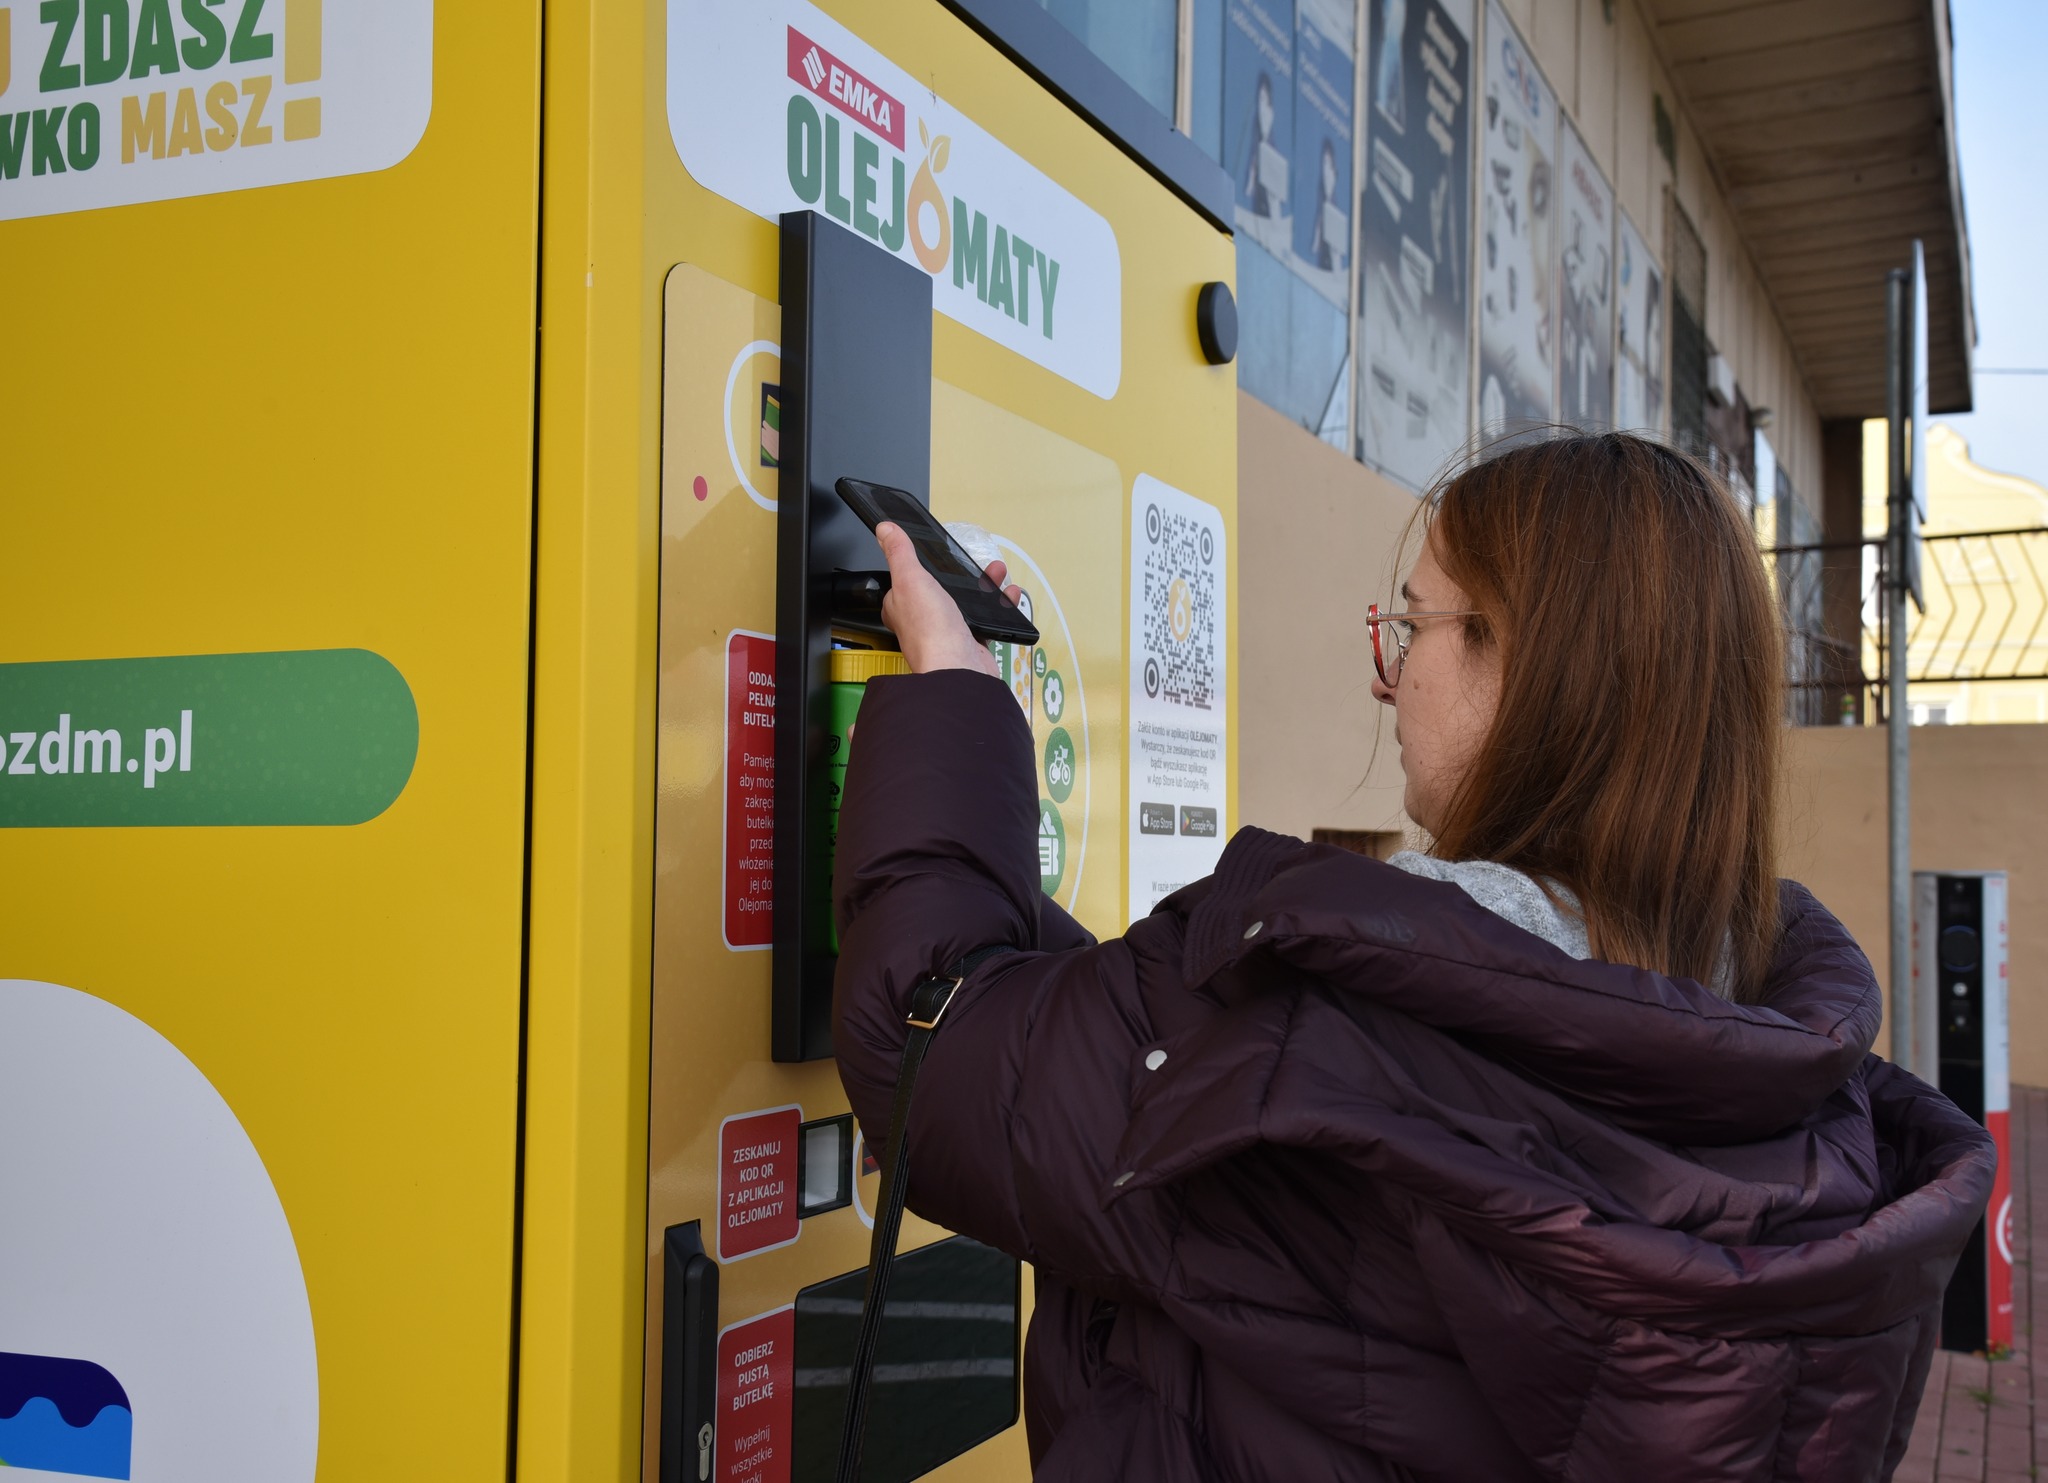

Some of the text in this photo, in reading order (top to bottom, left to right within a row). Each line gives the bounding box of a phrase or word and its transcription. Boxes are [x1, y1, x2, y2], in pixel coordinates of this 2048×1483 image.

[40, 0, 273, 92] ZDASZ
[829, 64, 891, 133] EMKA
[0, 710, 192, 788] zdm.pl
[739, 773, 754, 791] aby
[1149, 817, 1172, 830] App Store
[1190, 818, 1206, 833] Google
[750, 836, 773, 852] przed
[749, 876, 772, 894] jej do
[732, 1140, 781, 1164] ZESKANUJ
[740, 1163, 774, 1183] KOD QR
[728, 1181, 784, 1207] Z APLIKACJI
[728, 1201, 784, 1228] OLEJOMATY
[735, 1340, 774, 1368] ODBIERZ
[738, 1364, 769, 1387] PUSTĄ
[733, 1382, 774, 1411] BUTELKĘ
[734, 1424, 770, 1453] Wypełnij
[731, 1446, 773, 1475] wszystkie
